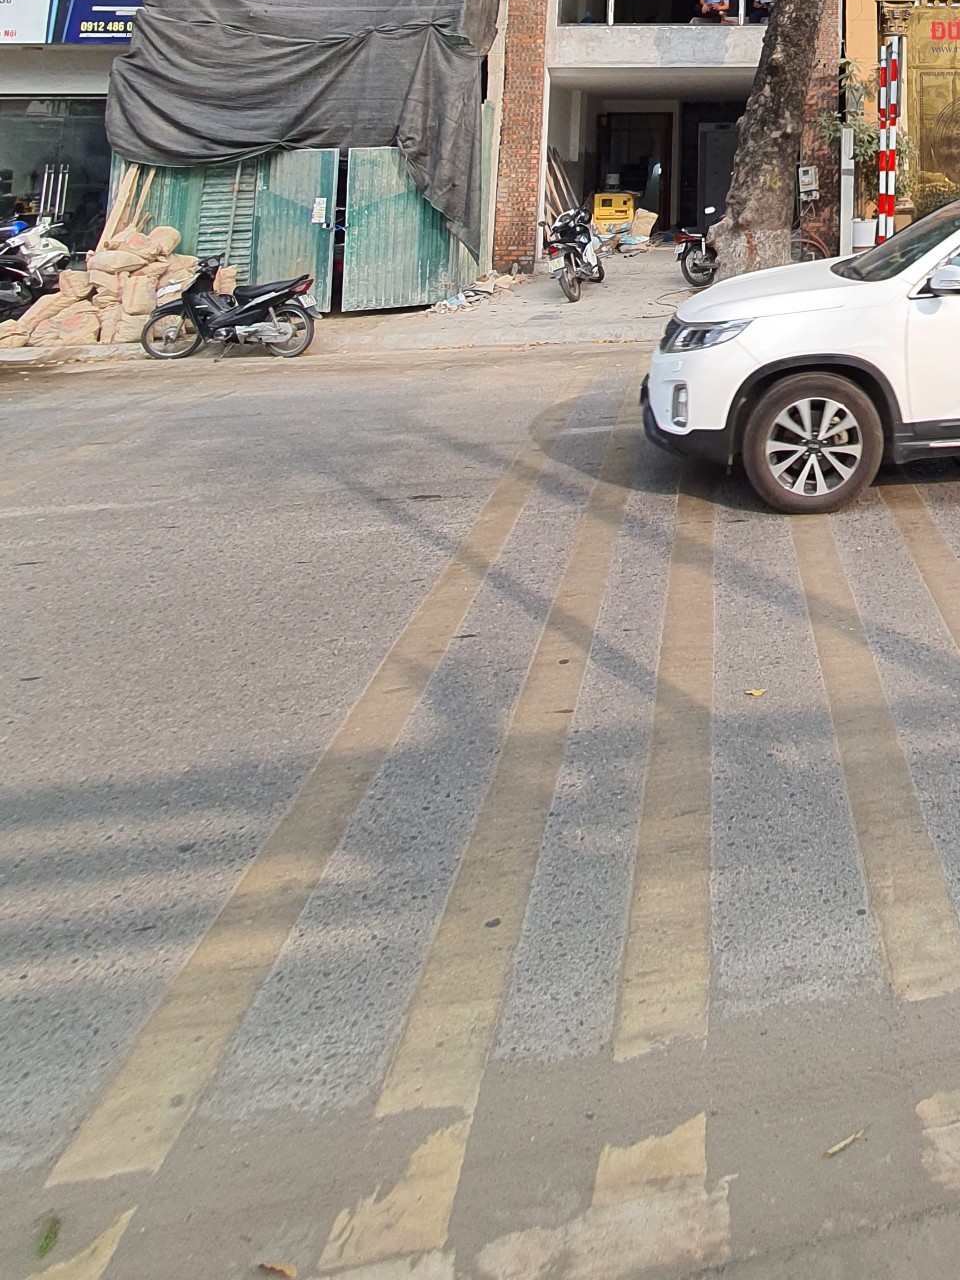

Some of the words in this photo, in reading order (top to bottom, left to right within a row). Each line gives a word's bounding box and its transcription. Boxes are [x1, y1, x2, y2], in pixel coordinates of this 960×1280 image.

[81, 21, 105, 32] 0912
[107, 21, 125, 32] 486
[4, 29, 17, 39] Nội
